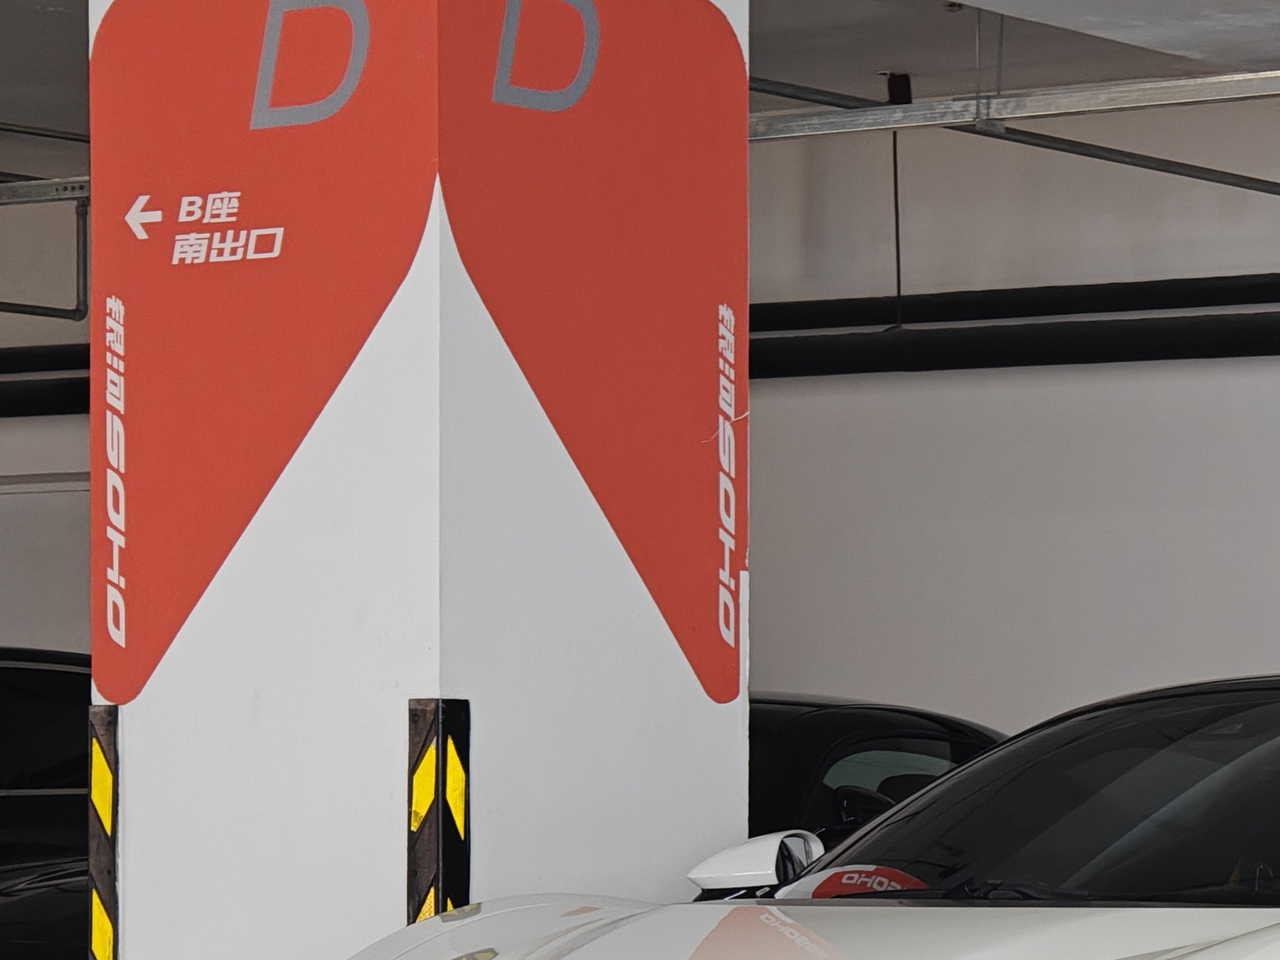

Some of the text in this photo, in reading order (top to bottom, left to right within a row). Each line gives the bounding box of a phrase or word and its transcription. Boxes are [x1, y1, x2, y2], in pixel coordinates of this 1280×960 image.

[250, 0, 370, 130] D
[492, 0, 600, 113] D
[178, 192, 241, 223] B座
[172, 228, 284, 264] 南出口
